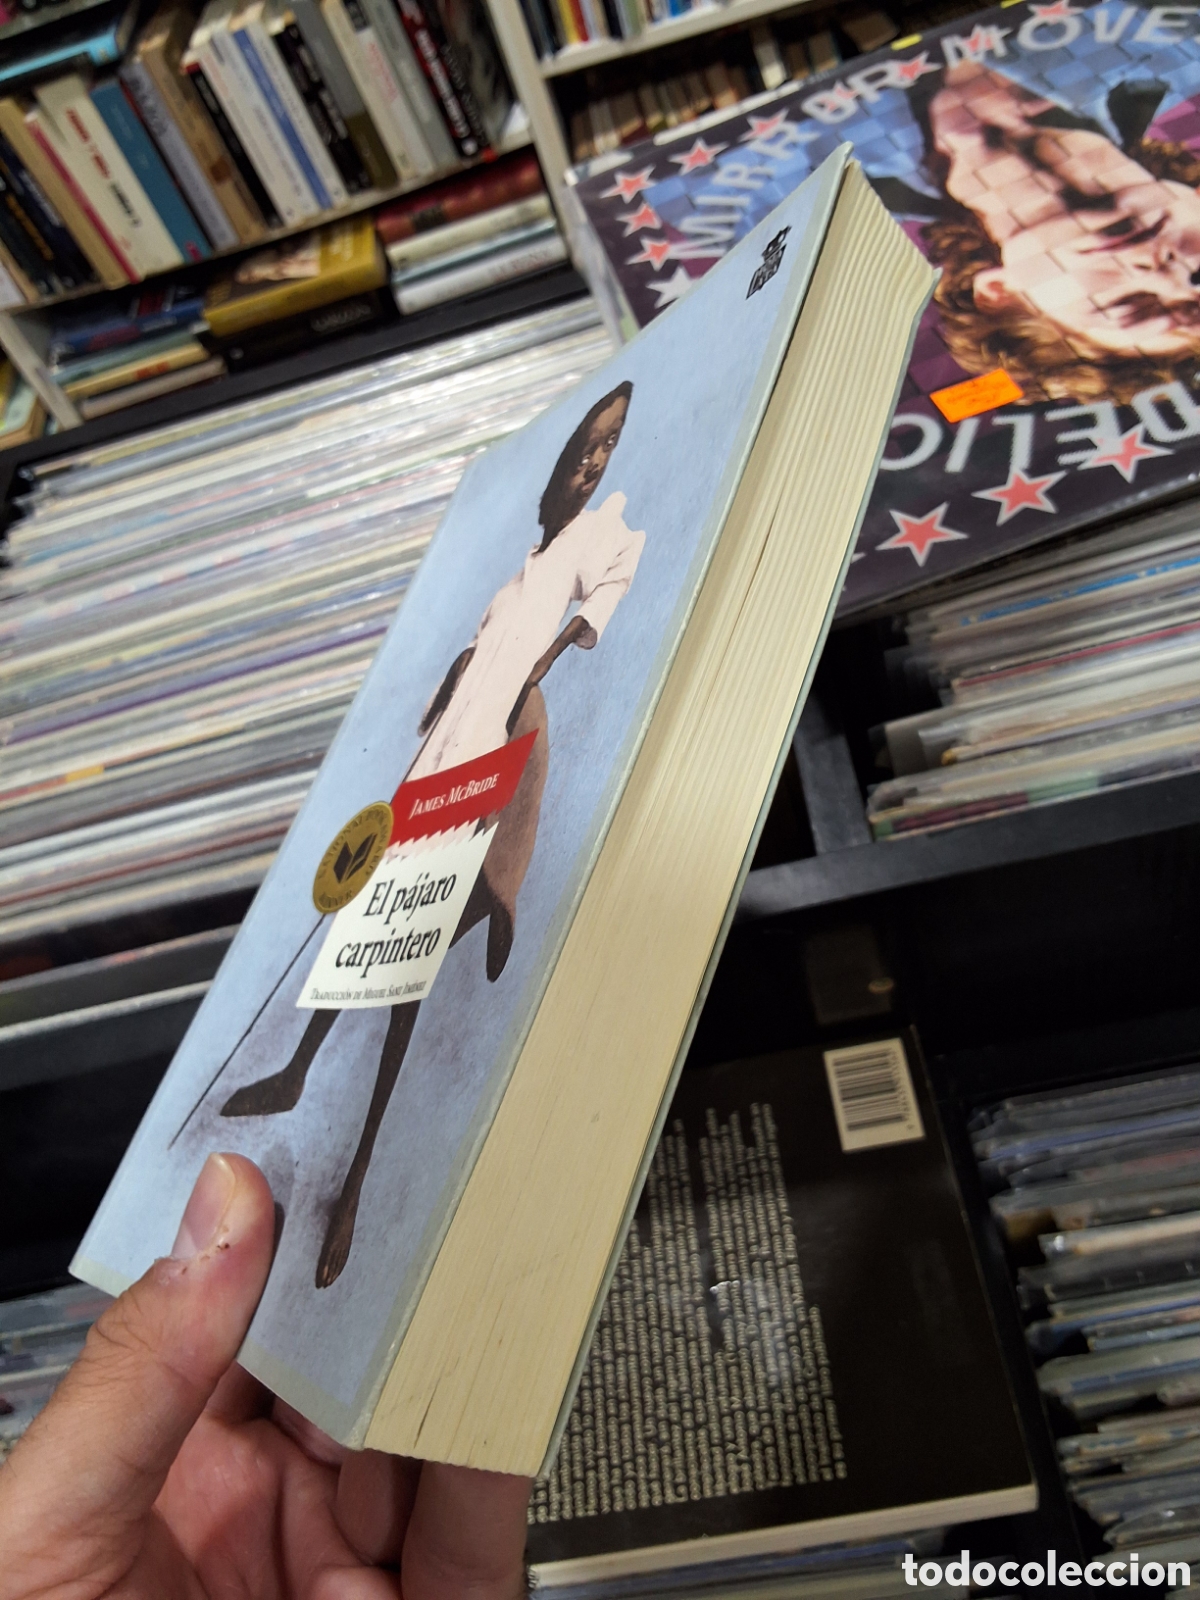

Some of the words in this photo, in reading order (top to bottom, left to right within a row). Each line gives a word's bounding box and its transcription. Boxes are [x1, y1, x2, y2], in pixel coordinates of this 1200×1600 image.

[941, 4, 1200, 70] MOVE
[362, 877, 395, 917] El
[383, 872, 458, 925] pájaro
[334, 926, 442, 979] carpintero
